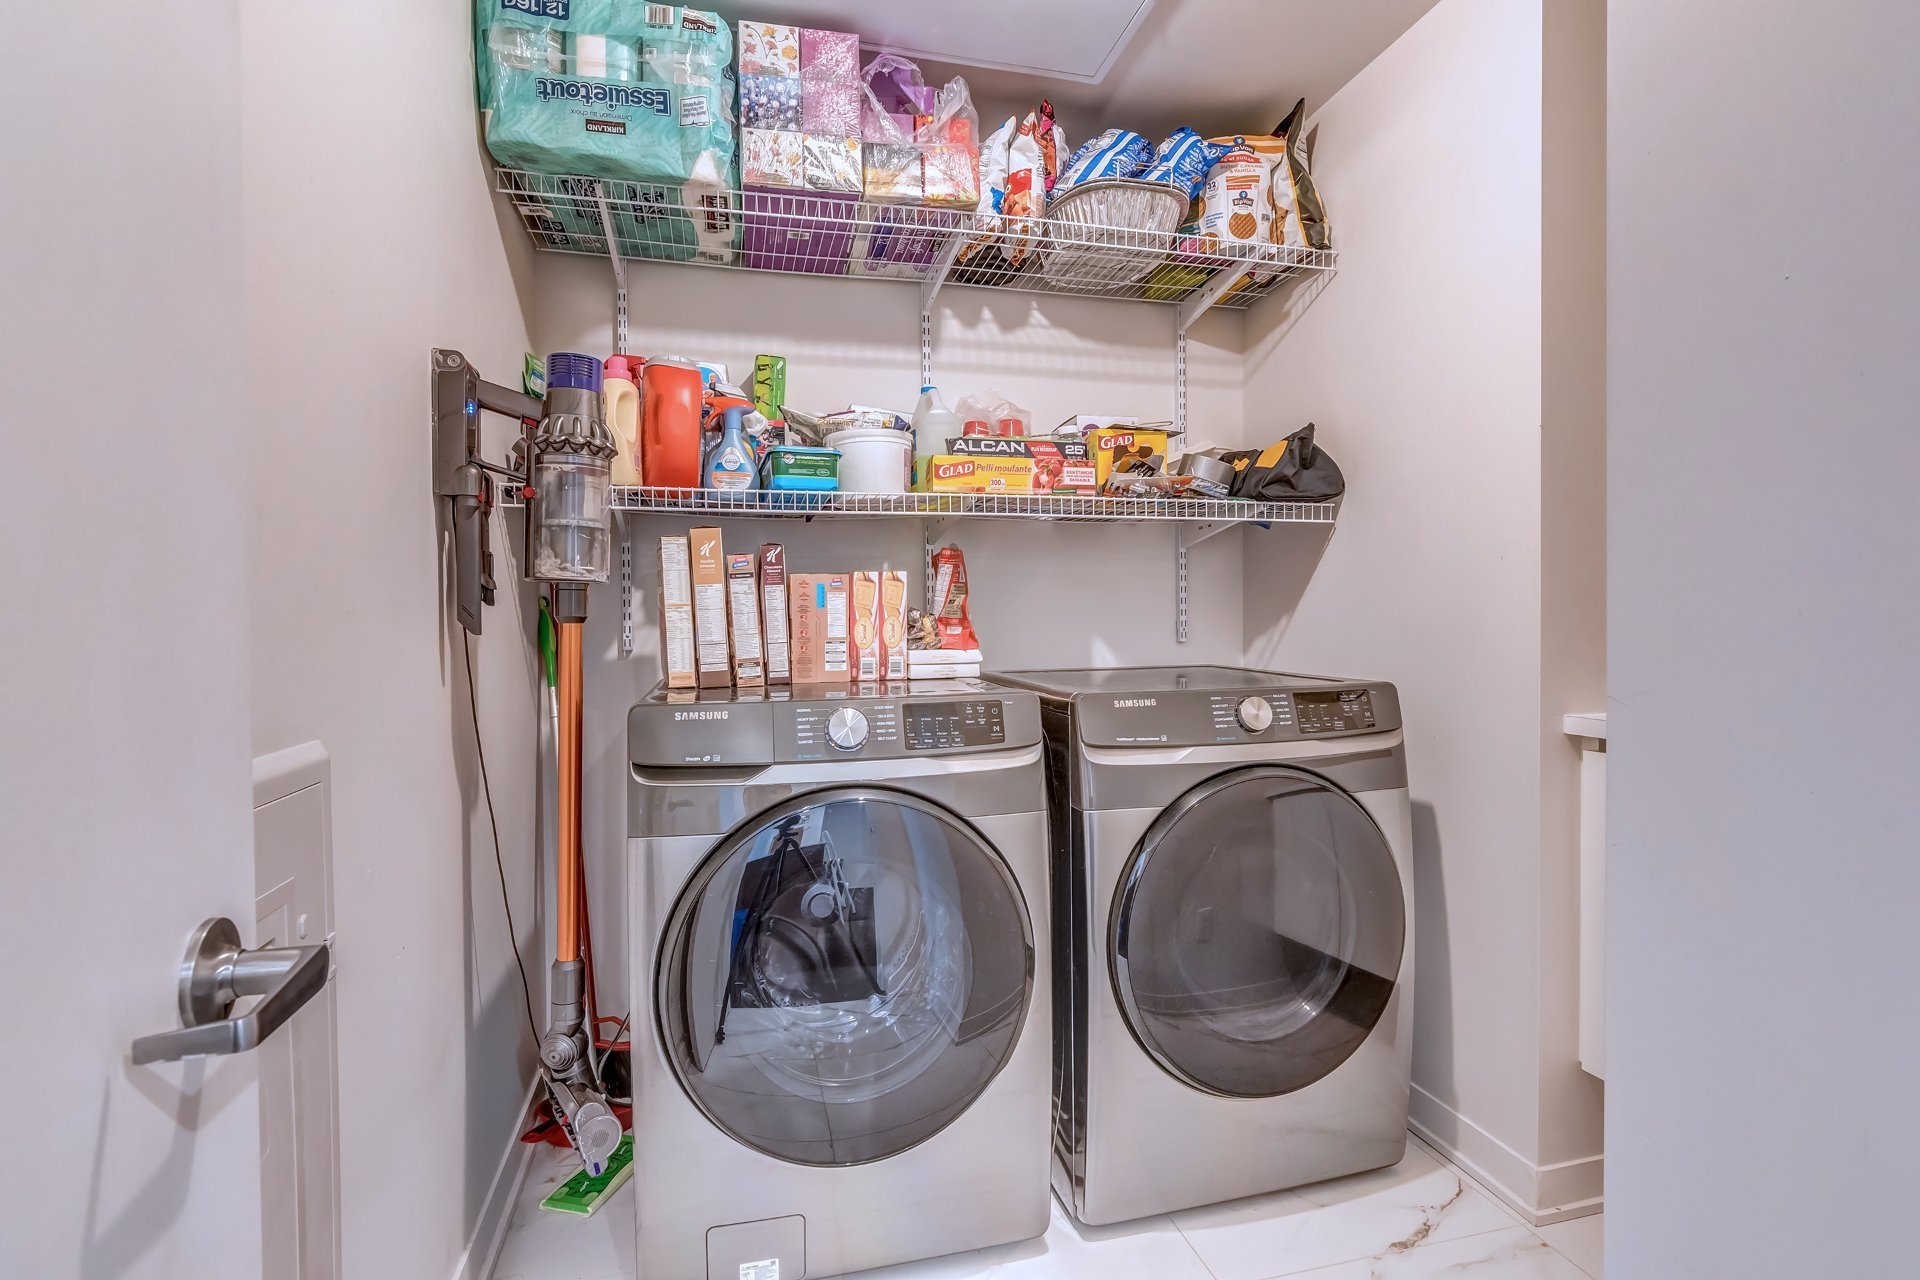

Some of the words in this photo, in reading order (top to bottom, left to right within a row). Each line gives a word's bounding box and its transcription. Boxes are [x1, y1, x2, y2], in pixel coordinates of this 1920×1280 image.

[588, 124, 624, 134] KIRKLAND
[1207, 181, 1216, 190] 32
[953, 440, 1025, 453] ALCAN
[1101, 435, 1134, 449] GLAD
[939, 463, 974, 478] GLAD
[976, 464, 993, 472] Pelli
[995, 465, 1033, 473] moulante
[700, 540, 716, 556] K
[766, 546, 782, 563] K
[1113, 698, 1157, 708] SAMSUNG
[674, 711, 729, 721] SAMSUNG
